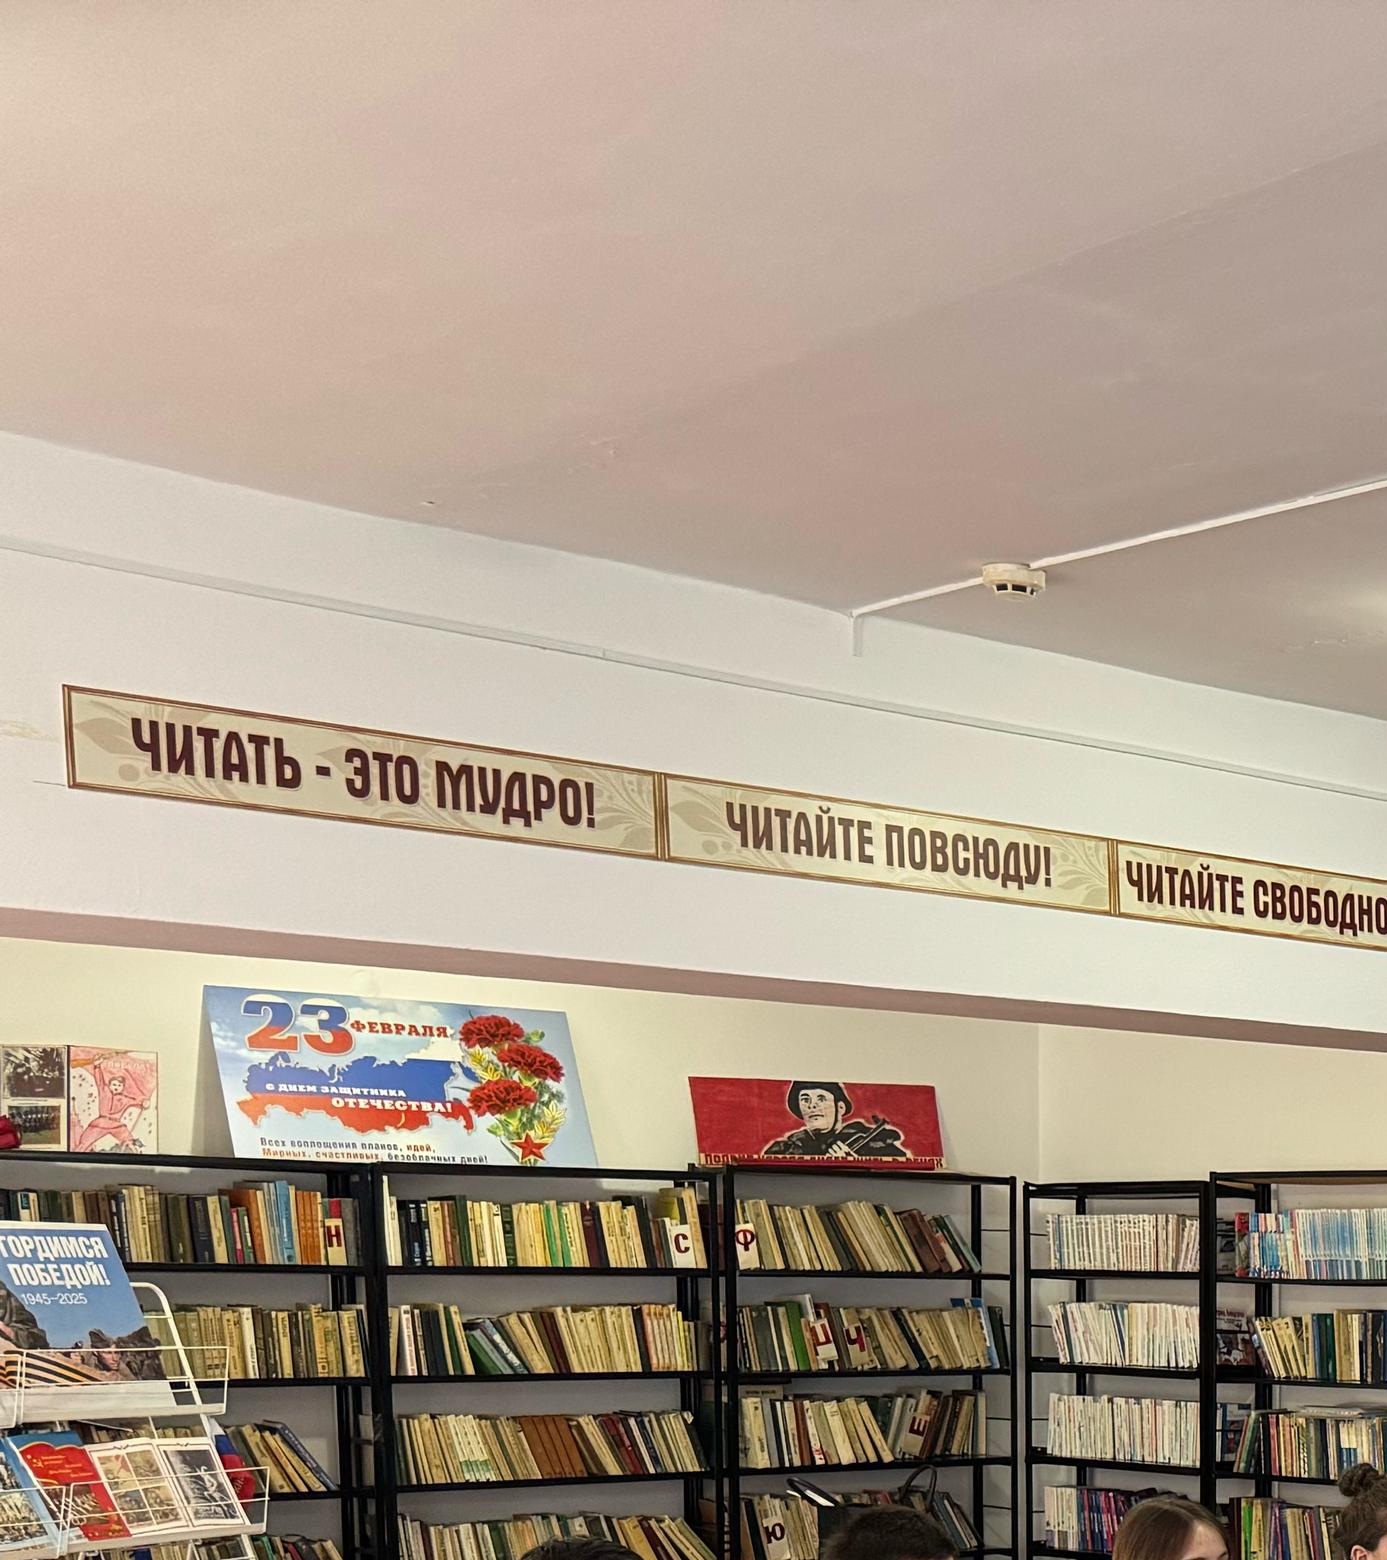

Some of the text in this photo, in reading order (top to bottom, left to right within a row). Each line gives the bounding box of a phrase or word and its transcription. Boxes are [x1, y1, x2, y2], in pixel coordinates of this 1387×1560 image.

[130, 716, 302, 790] ЧИТАТЬ
[345, 747, 420, 805] ЭТО
[436, 759, 597, 829] МУДРО!
[725, 800, 1052, 890] ЧИТАЙТЕ ПОВСЮДУ!
[1125, 860, 1245, 917] ЧИТАЙТЕ
[241, 993, 451, 1056] 23 ФЕВРАЛЯ
[265, 1083, 275, 1091] С
[320, 1085, 407, 1098] ЗАЩИТНИКА
[331, 1097, 453, 1113] ОТЕЧЕСТВА!
[0, 1235, 109, 1262] ГОРДИМСЯ
[674, 1233, 689, 1253] С
[735, 1229, 756, 1251] Ф
[7, 1261, 111, 1290] ПОБЕДОЙ!
